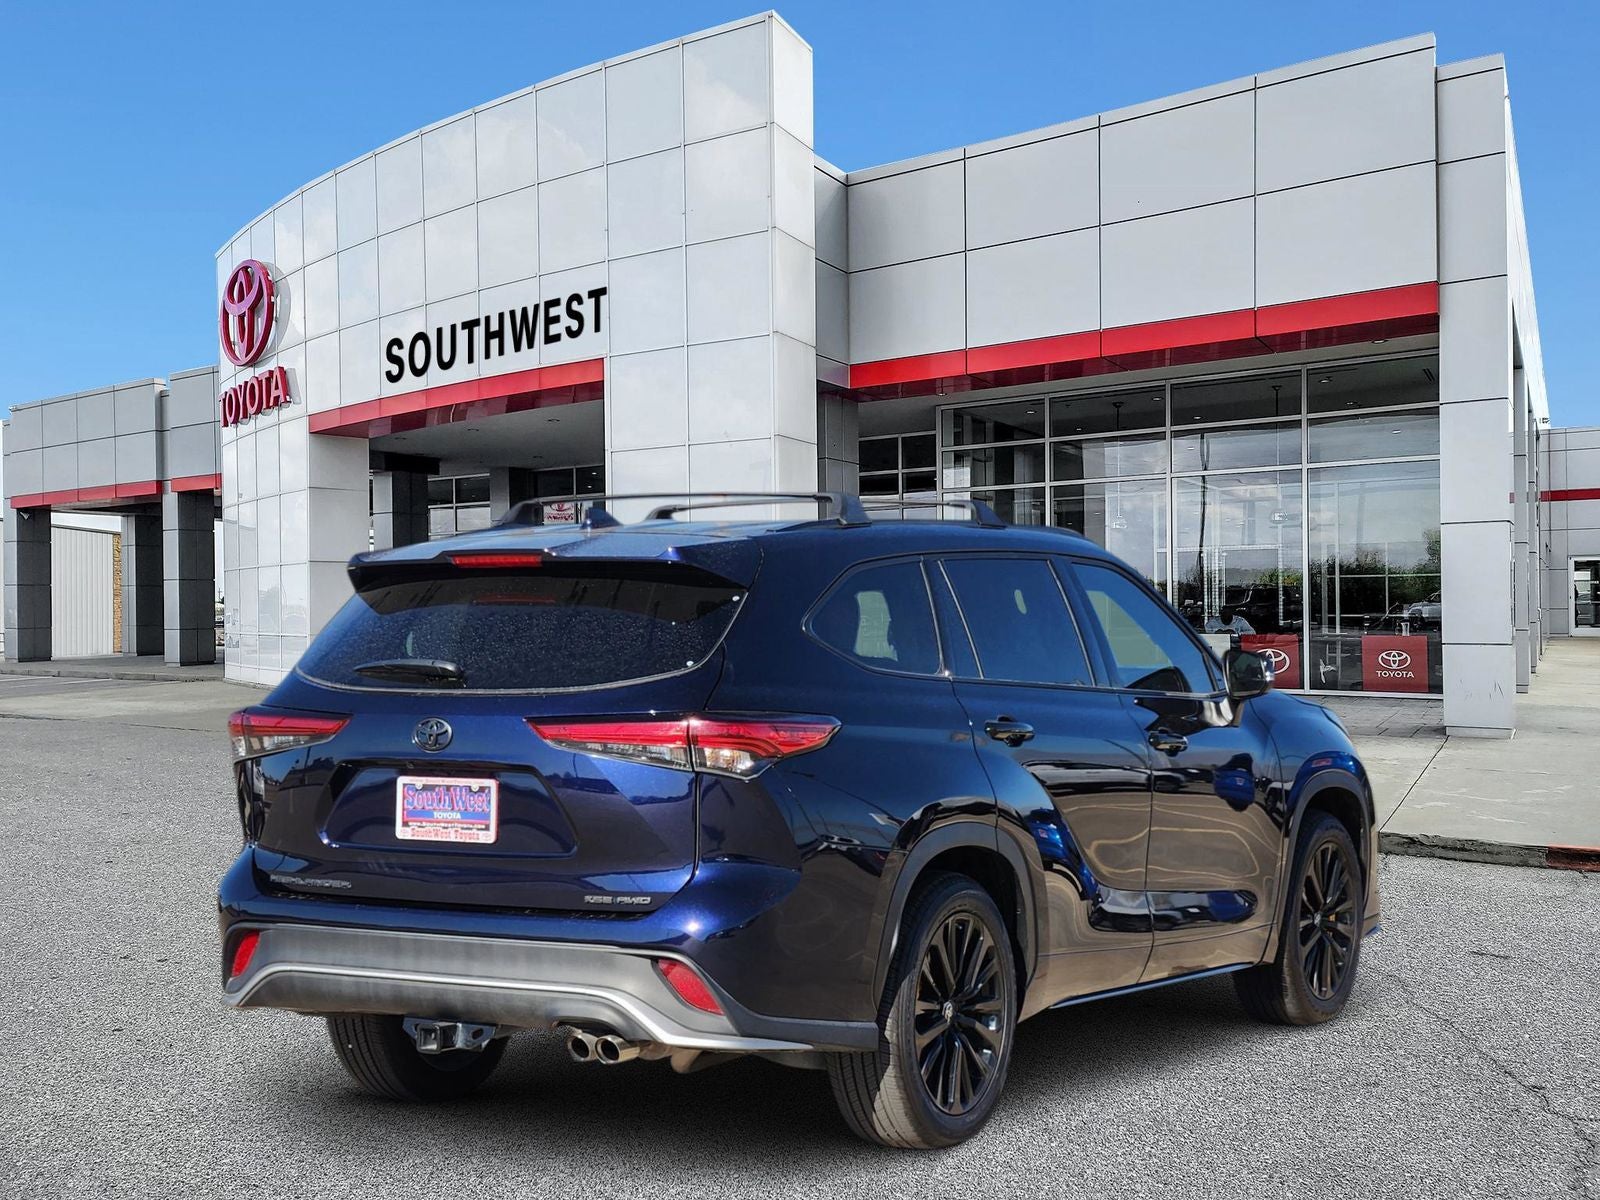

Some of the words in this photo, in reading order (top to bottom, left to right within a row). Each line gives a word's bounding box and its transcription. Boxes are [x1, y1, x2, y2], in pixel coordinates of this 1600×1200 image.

[385, 287, 607, 383] SOUTHWEST
[218, 366, 290, 427] TOYOTA
[1376, 670, 1415, 678] TOYOTA
[433, 811, 461, 819] TOYOTA
[616, 896, 651, 905] AWD
